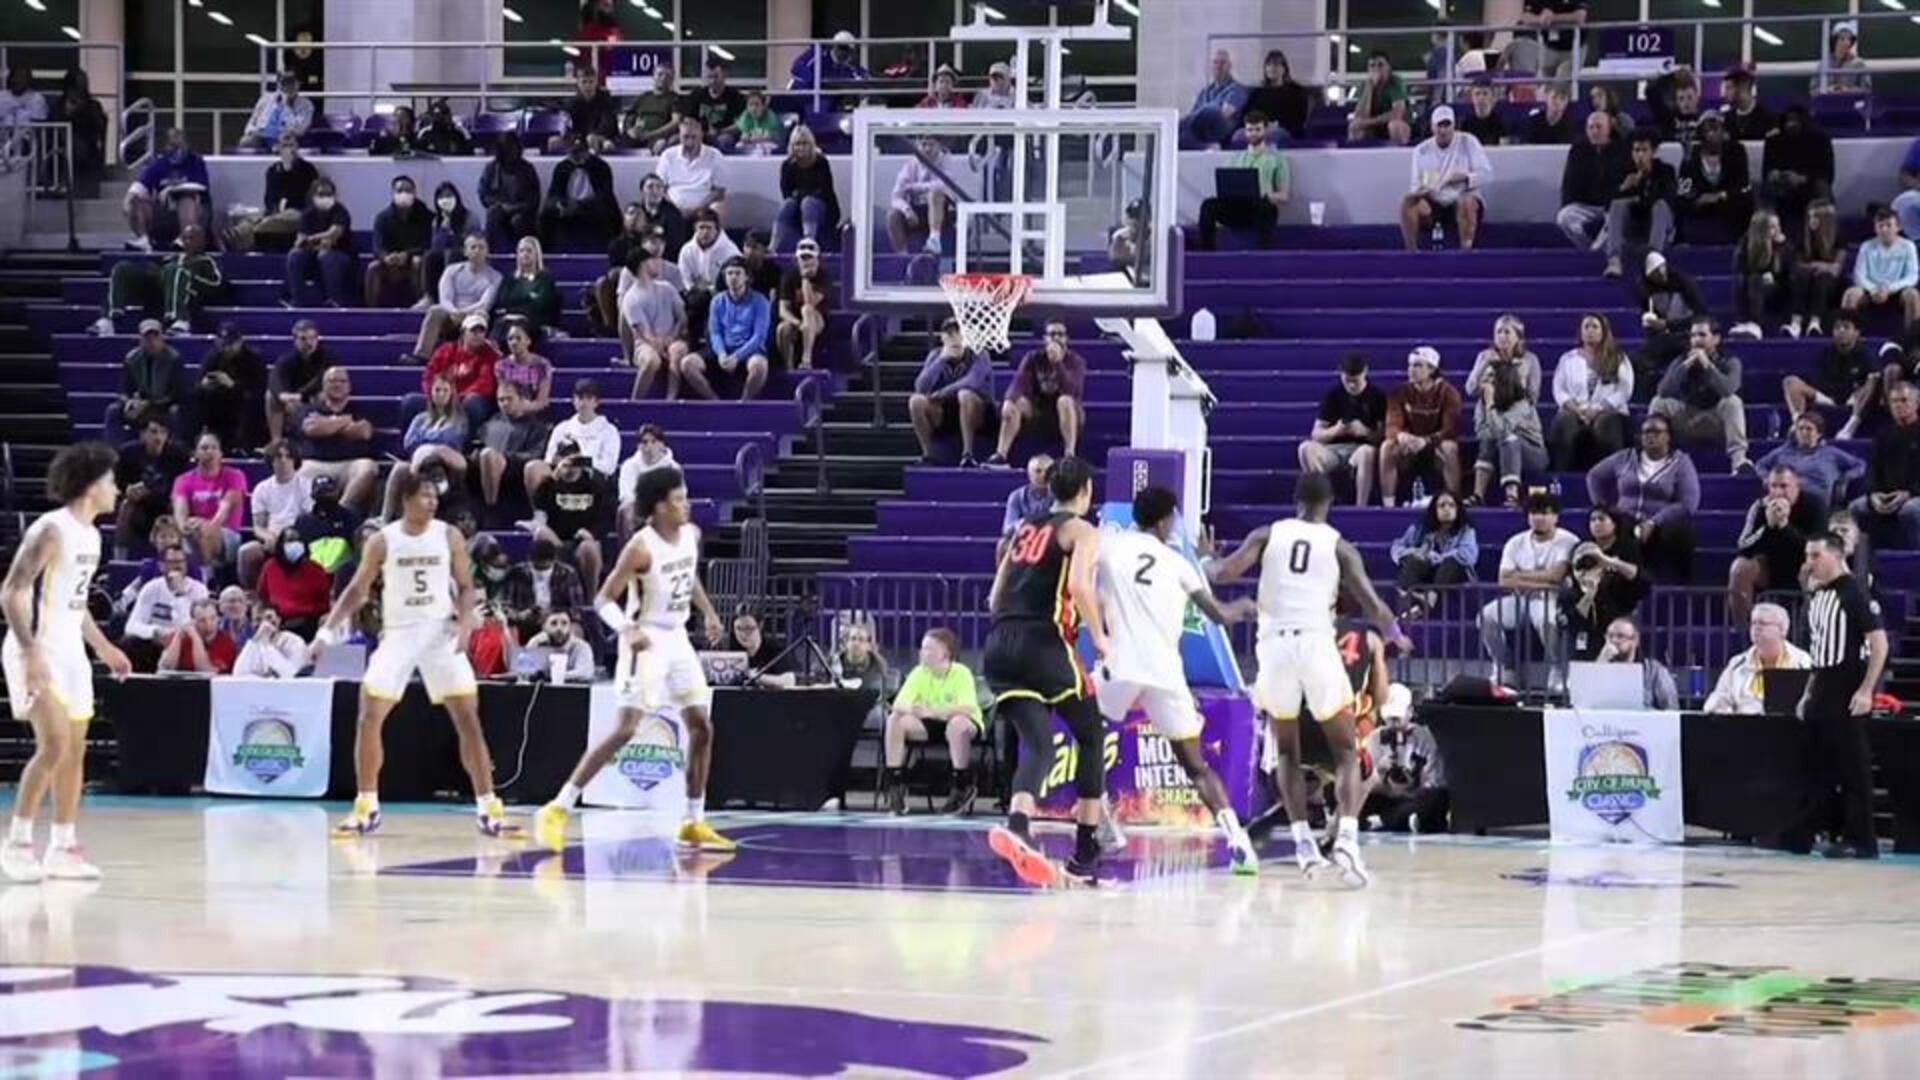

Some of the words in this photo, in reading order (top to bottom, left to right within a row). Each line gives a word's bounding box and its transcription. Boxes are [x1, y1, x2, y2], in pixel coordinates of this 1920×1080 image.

[1627, 32, 1661, 53] 102
[632, 52, 659, 72] 101
[1011, 523, 1056, 565] 30
[1289, 539, 1311, 574] 0
[414, 569, 428, 593] 5
[1134, 552, 1156, 585] 2
